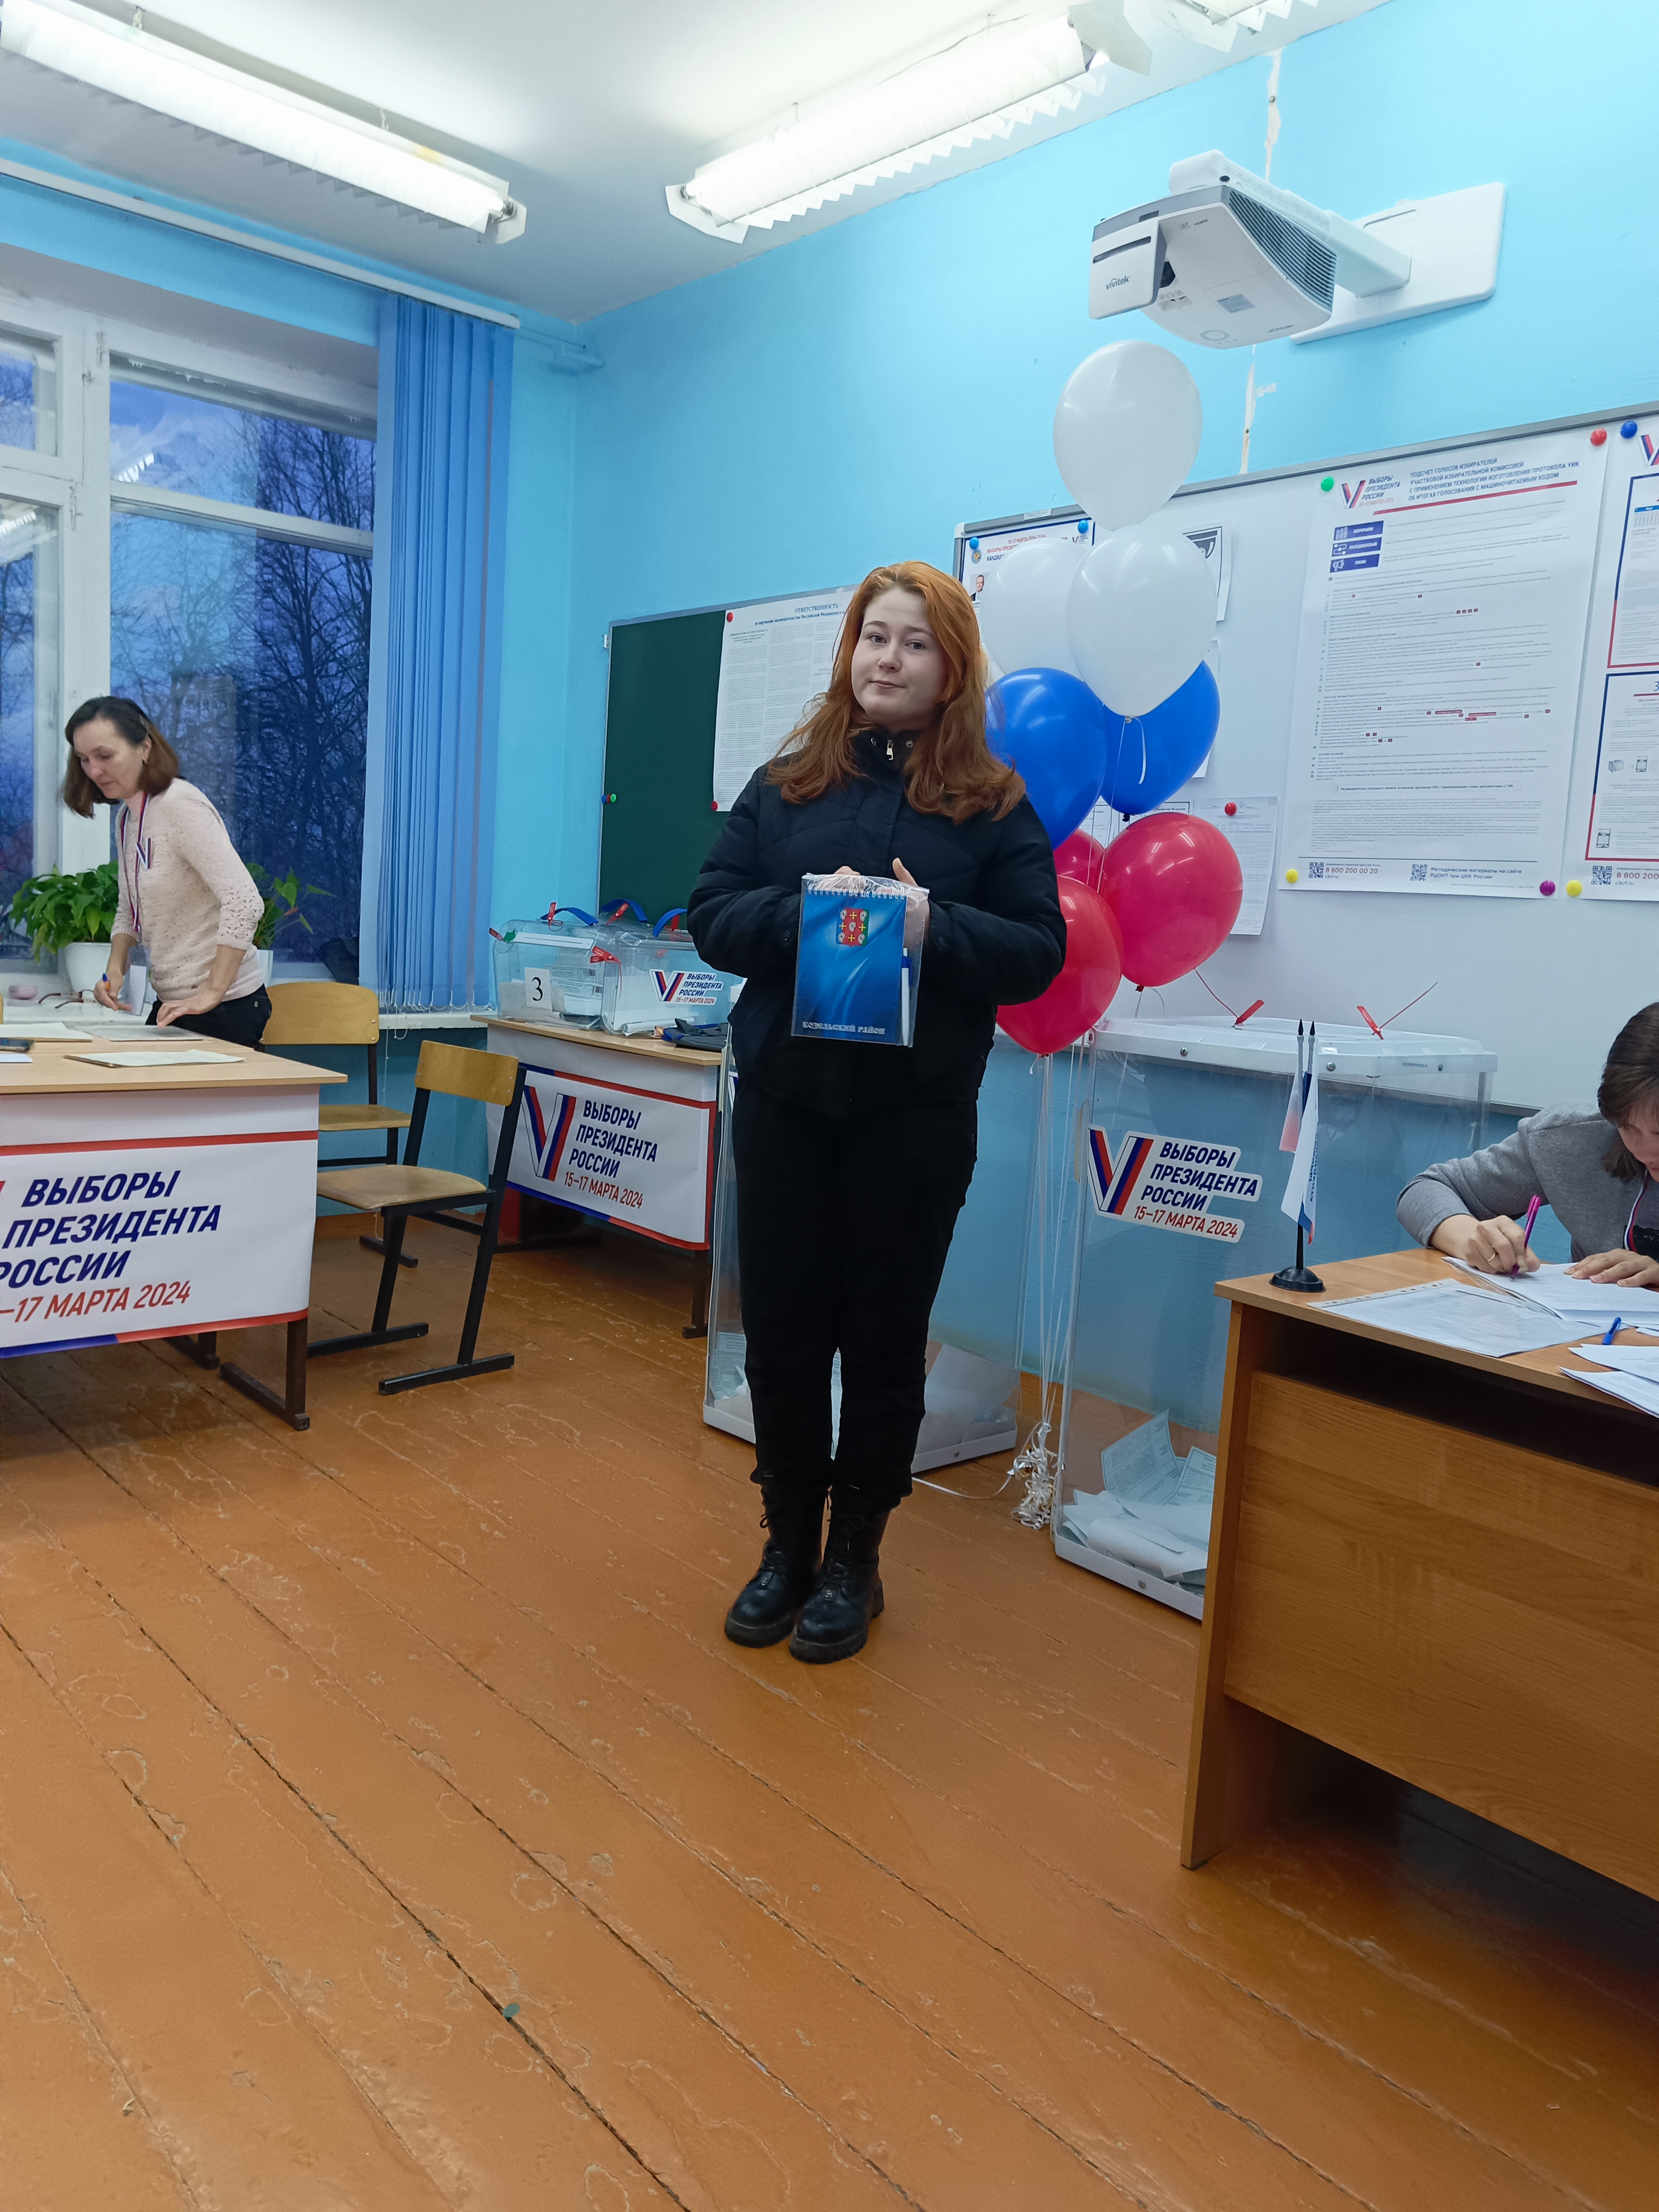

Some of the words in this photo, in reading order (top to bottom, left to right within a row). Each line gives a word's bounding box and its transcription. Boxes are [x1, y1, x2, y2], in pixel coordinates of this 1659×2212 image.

[1106, 275, 1130, 289] vivitek
[1369, 475, 1394, 485] ВЫБОРЫ
[1410, 469, 1433, 478] ПОДСЧЕТ
[1434, 465, 1458, 473] ГОЛОСОВ
[1460, 457, 1497, 469] ИЗБИРАТЕЛЕЙ
[1410, 475, 1443, 485] УЧАСТКОВОЙ
[1444, 467, 1489, 479] ИЗБИРАТЕЛЬНОЙ
[1490, 461, 1524, 472] КОМИССИЕЙ
[1414, 481, 1452, 493] ПРИМЕНЕНИЕМ
[1454, 476, 1487, 486] ТЕХНОЛОГИИ
[1489, 469, 1531, 481] ИЗГОТОВЛЕНИЯ
[1532, 464, 1566, 473] ПРОТОКОЛА
[1361, 492, 1384, 500] РОССИИ
[1365, 481, 1401, 493] ПРЕЗИДЕНТА
[1437, 486, 1475, 496] ГОЛОСОВАНИЯ
[1481, 477, 1537, 489] МАШИНОЧИТАЕМЫМ
[1538, 472, 1560, 481] КОДОМ
[794, 603, 838, 613] ОТВЕТСТВЕННОСТЬ
[531, 977, 543, 1001] 3
[583, 1100, 642, 1130] ВЫБОРЫ
[576, 1125, 659, 1162] ПРЕЗИДЕНТА
[1160, 1142, 1236, 1168] ВЫБОРЫ
[568, 1148, 621, 1178] РОССИИ
[21, 1170, 180, 1208] ВЫБОРЫ
[1150, 1164, 1259, 1196] ПРЕЗИДЕНТА
[589, 1179, 619, 1202] МАРТА
[620, 1189, 643, 1209] 2024
[1141, 1185, 1208, 1211] РОССИИ
[2, 1205, 221, 1248] ПРЕЗИДЕНТА
[1165, 1211, 1206, 1232] МАРТА
[1207, 1220, 1238, 1238] 2024
[44, 1286, 130, 1320] МАРТА
[133, 1280, 191, 1309] 2024
